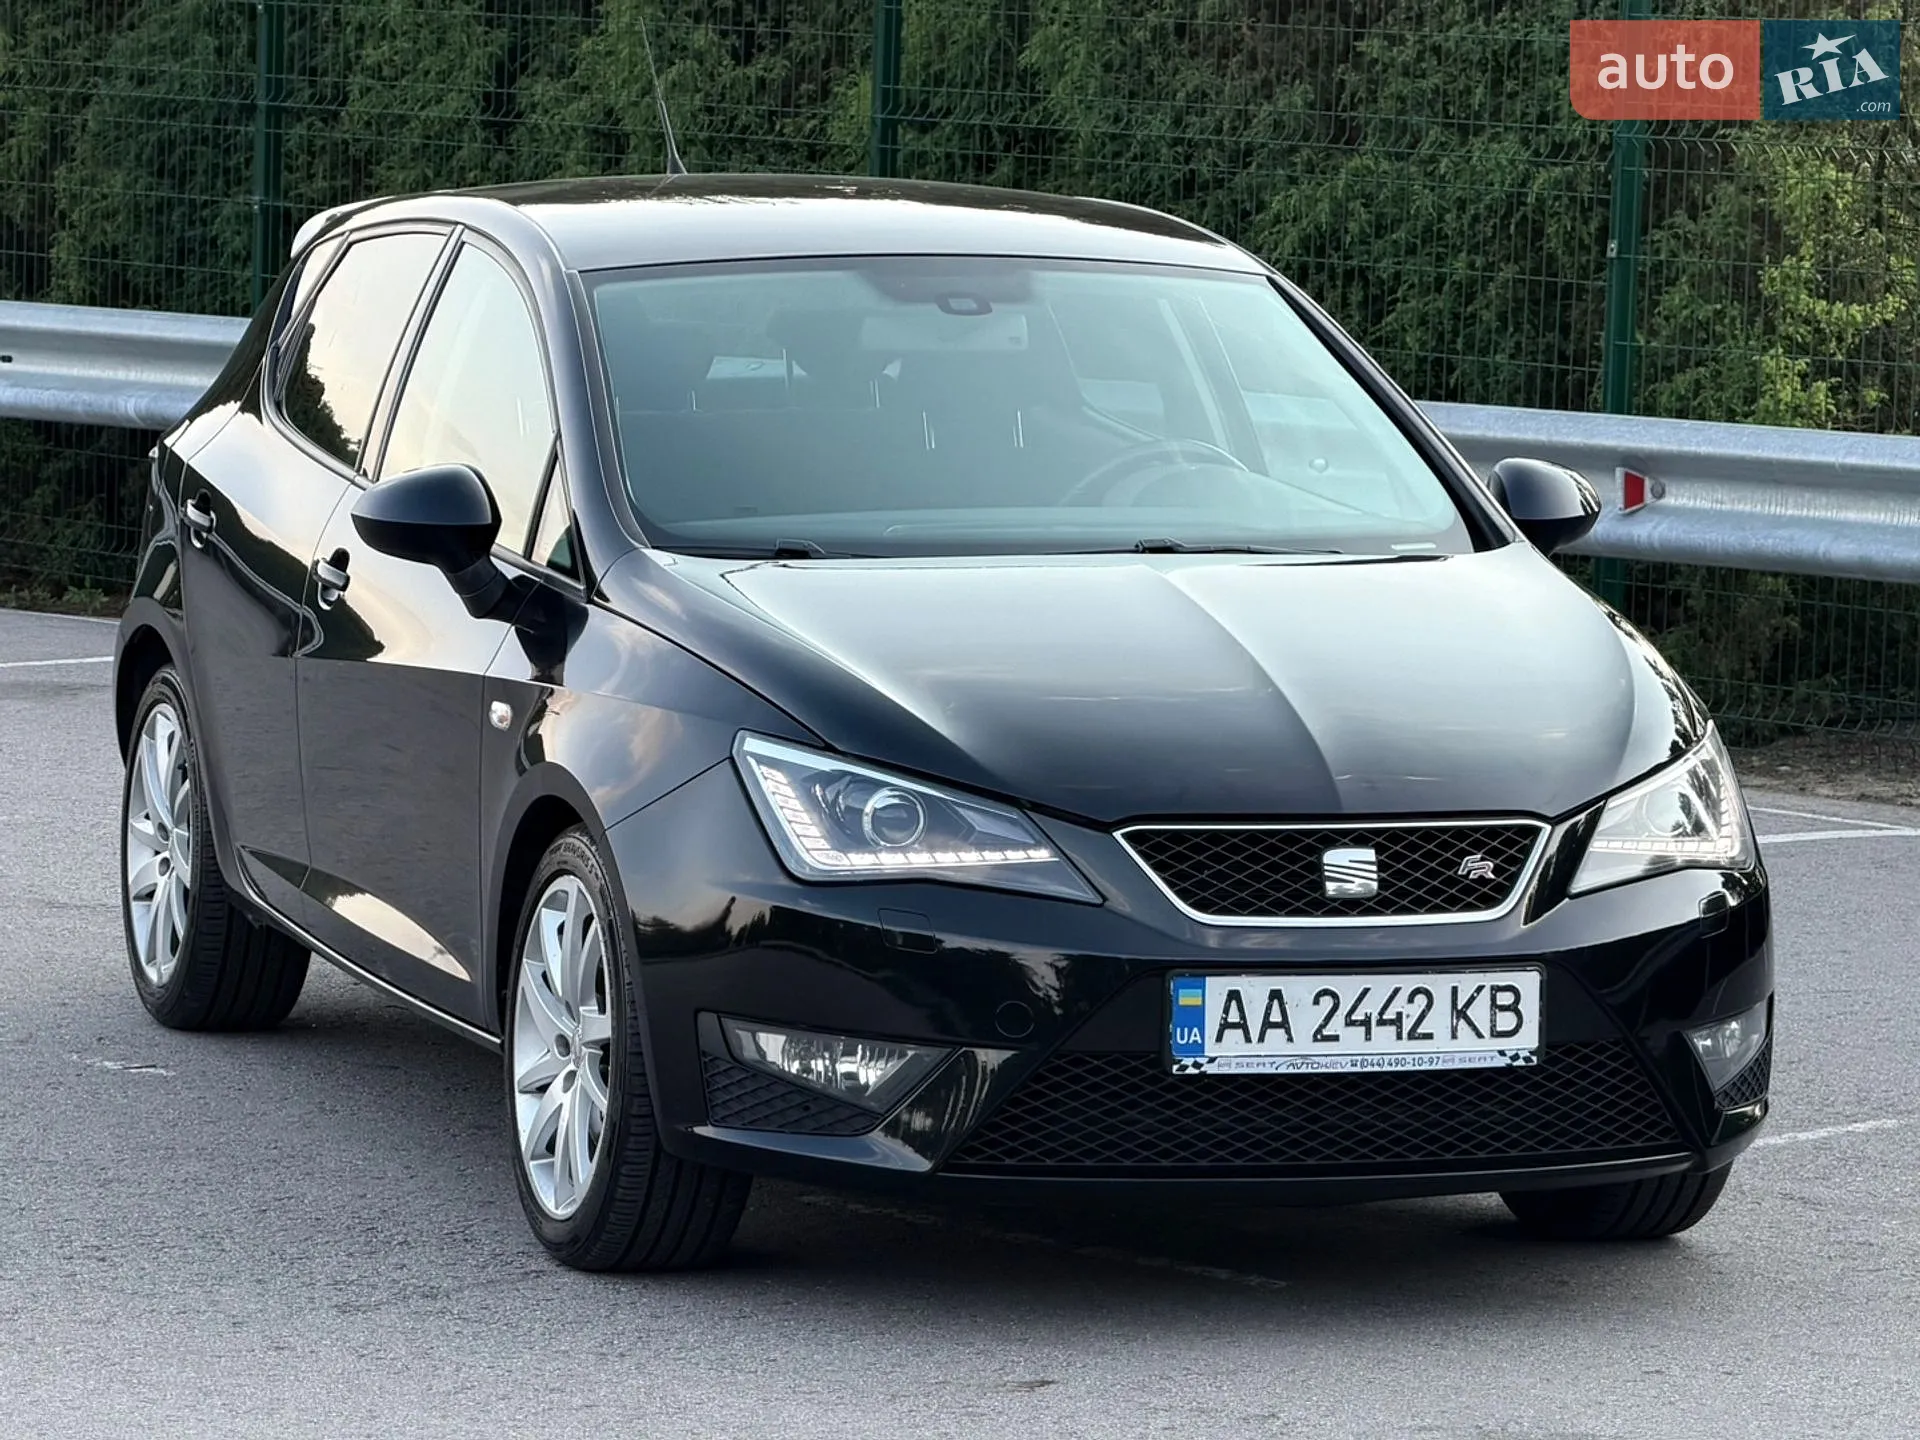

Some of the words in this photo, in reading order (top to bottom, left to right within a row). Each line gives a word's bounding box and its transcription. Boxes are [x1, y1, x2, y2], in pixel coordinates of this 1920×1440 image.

[1458, 854, 1496, 880] FR
[1215, 987, 1294, 1044] AA
[1312, 986, 1435, 1042] 2442
[1450, 983, 1524, 1039] KB
[1176, 1028, 1202, 1044] UA
[1234, 1061, 1277, 1070] SEAT
[1387, 1055, 1440, 1068] 490-10-97
[1458, 1054, 1498, 1064] SEAT
